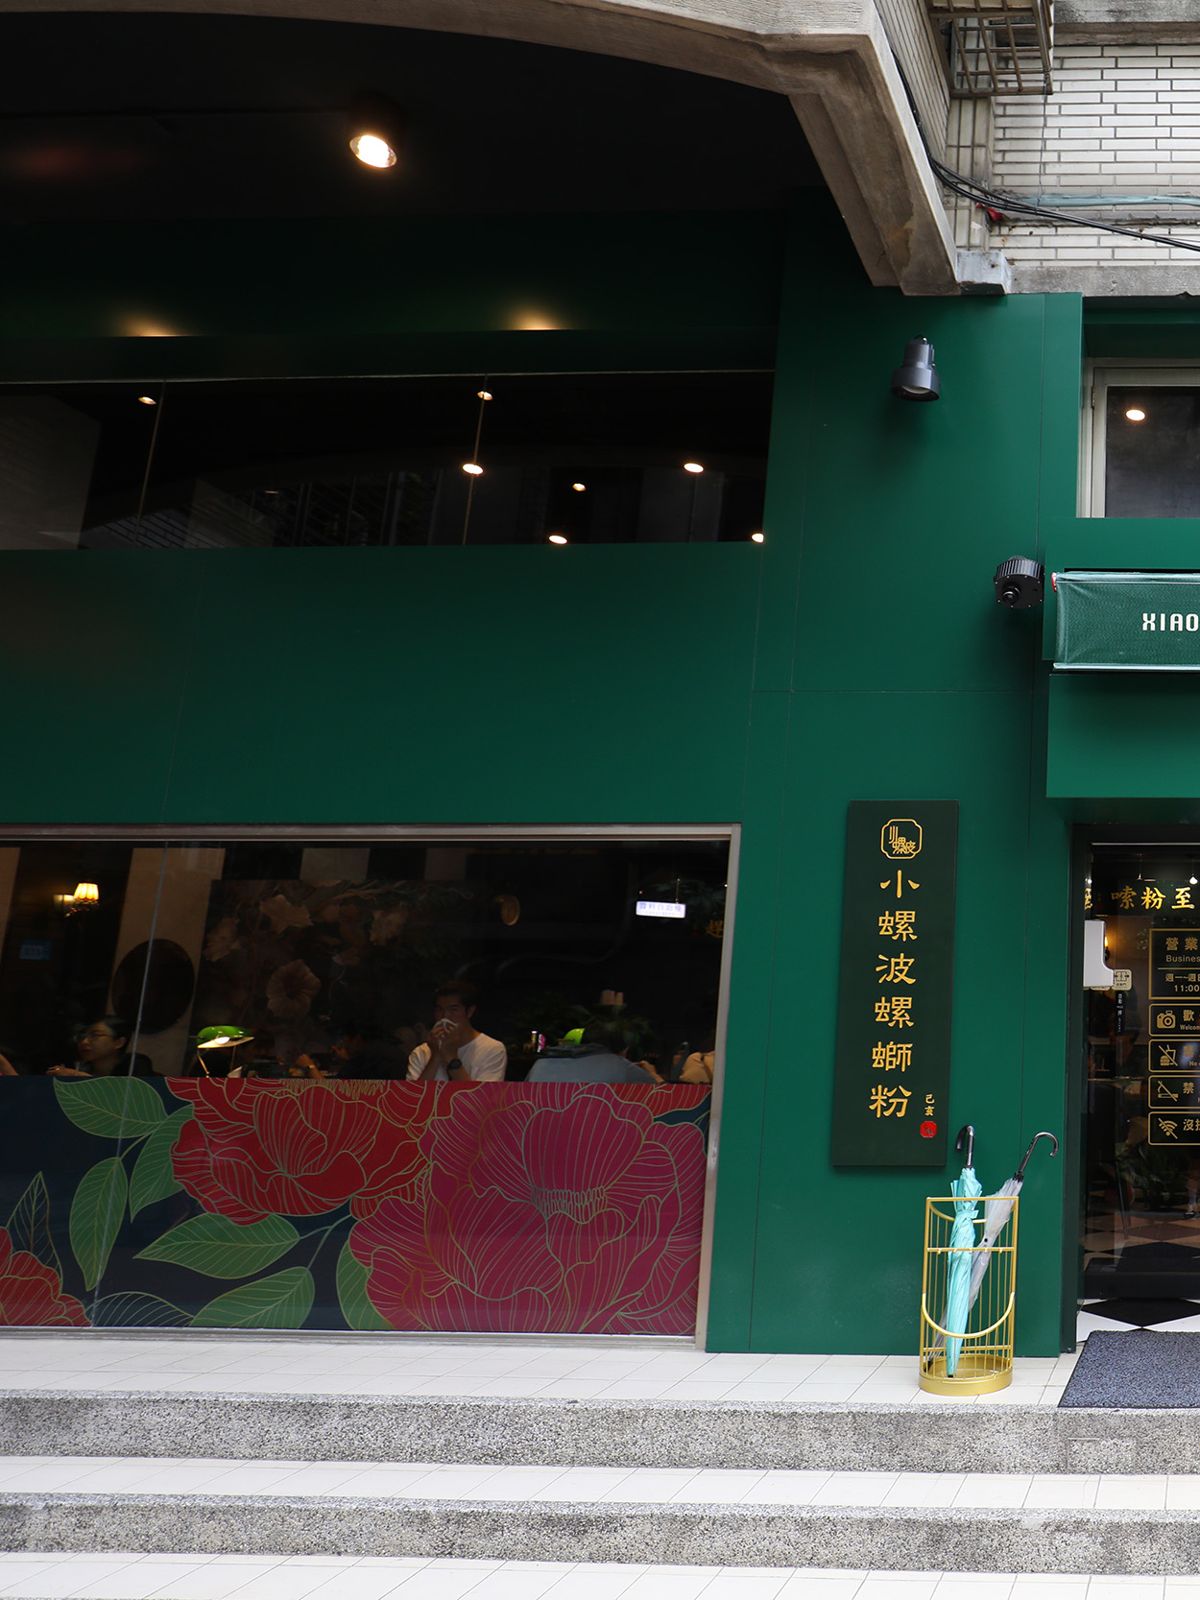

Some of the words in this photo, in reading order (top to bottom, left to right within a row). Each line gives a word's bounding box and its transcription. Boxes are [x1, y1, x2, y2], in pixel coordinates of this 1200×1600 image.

[1142, 613, 1199, 632] XIAO
[869, 869, 920, 1119] 小螺波螺螄粉
